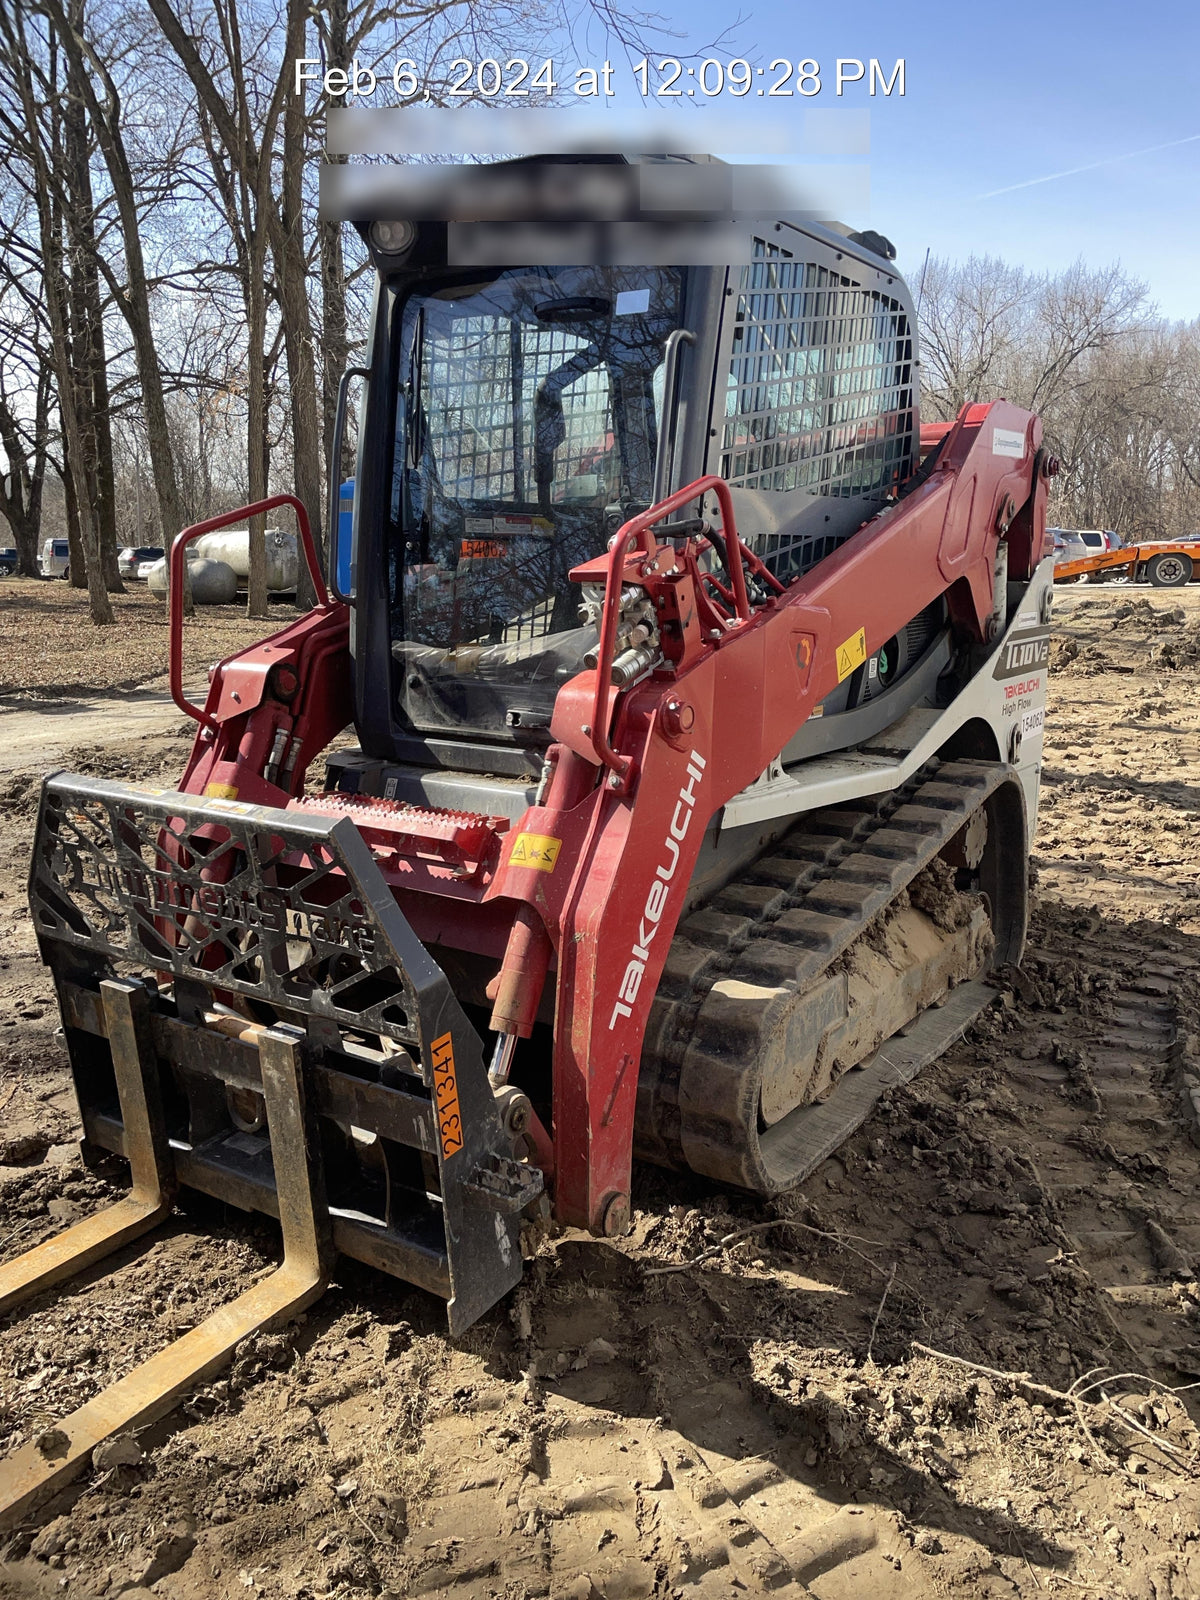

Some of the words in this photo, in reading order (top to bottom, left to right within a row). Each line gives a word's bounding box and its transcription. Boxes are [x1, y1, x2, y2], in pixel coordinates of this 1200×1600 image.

[1001, 702, 1017, 717] High
[1017, 698, 1032, 711] Flow
[1003, 678, 1040, 699] TAKEUCHI
[608, 749, 707, 1031] TAKEUCHI
[432, 1040, 462, 1155] 231341
